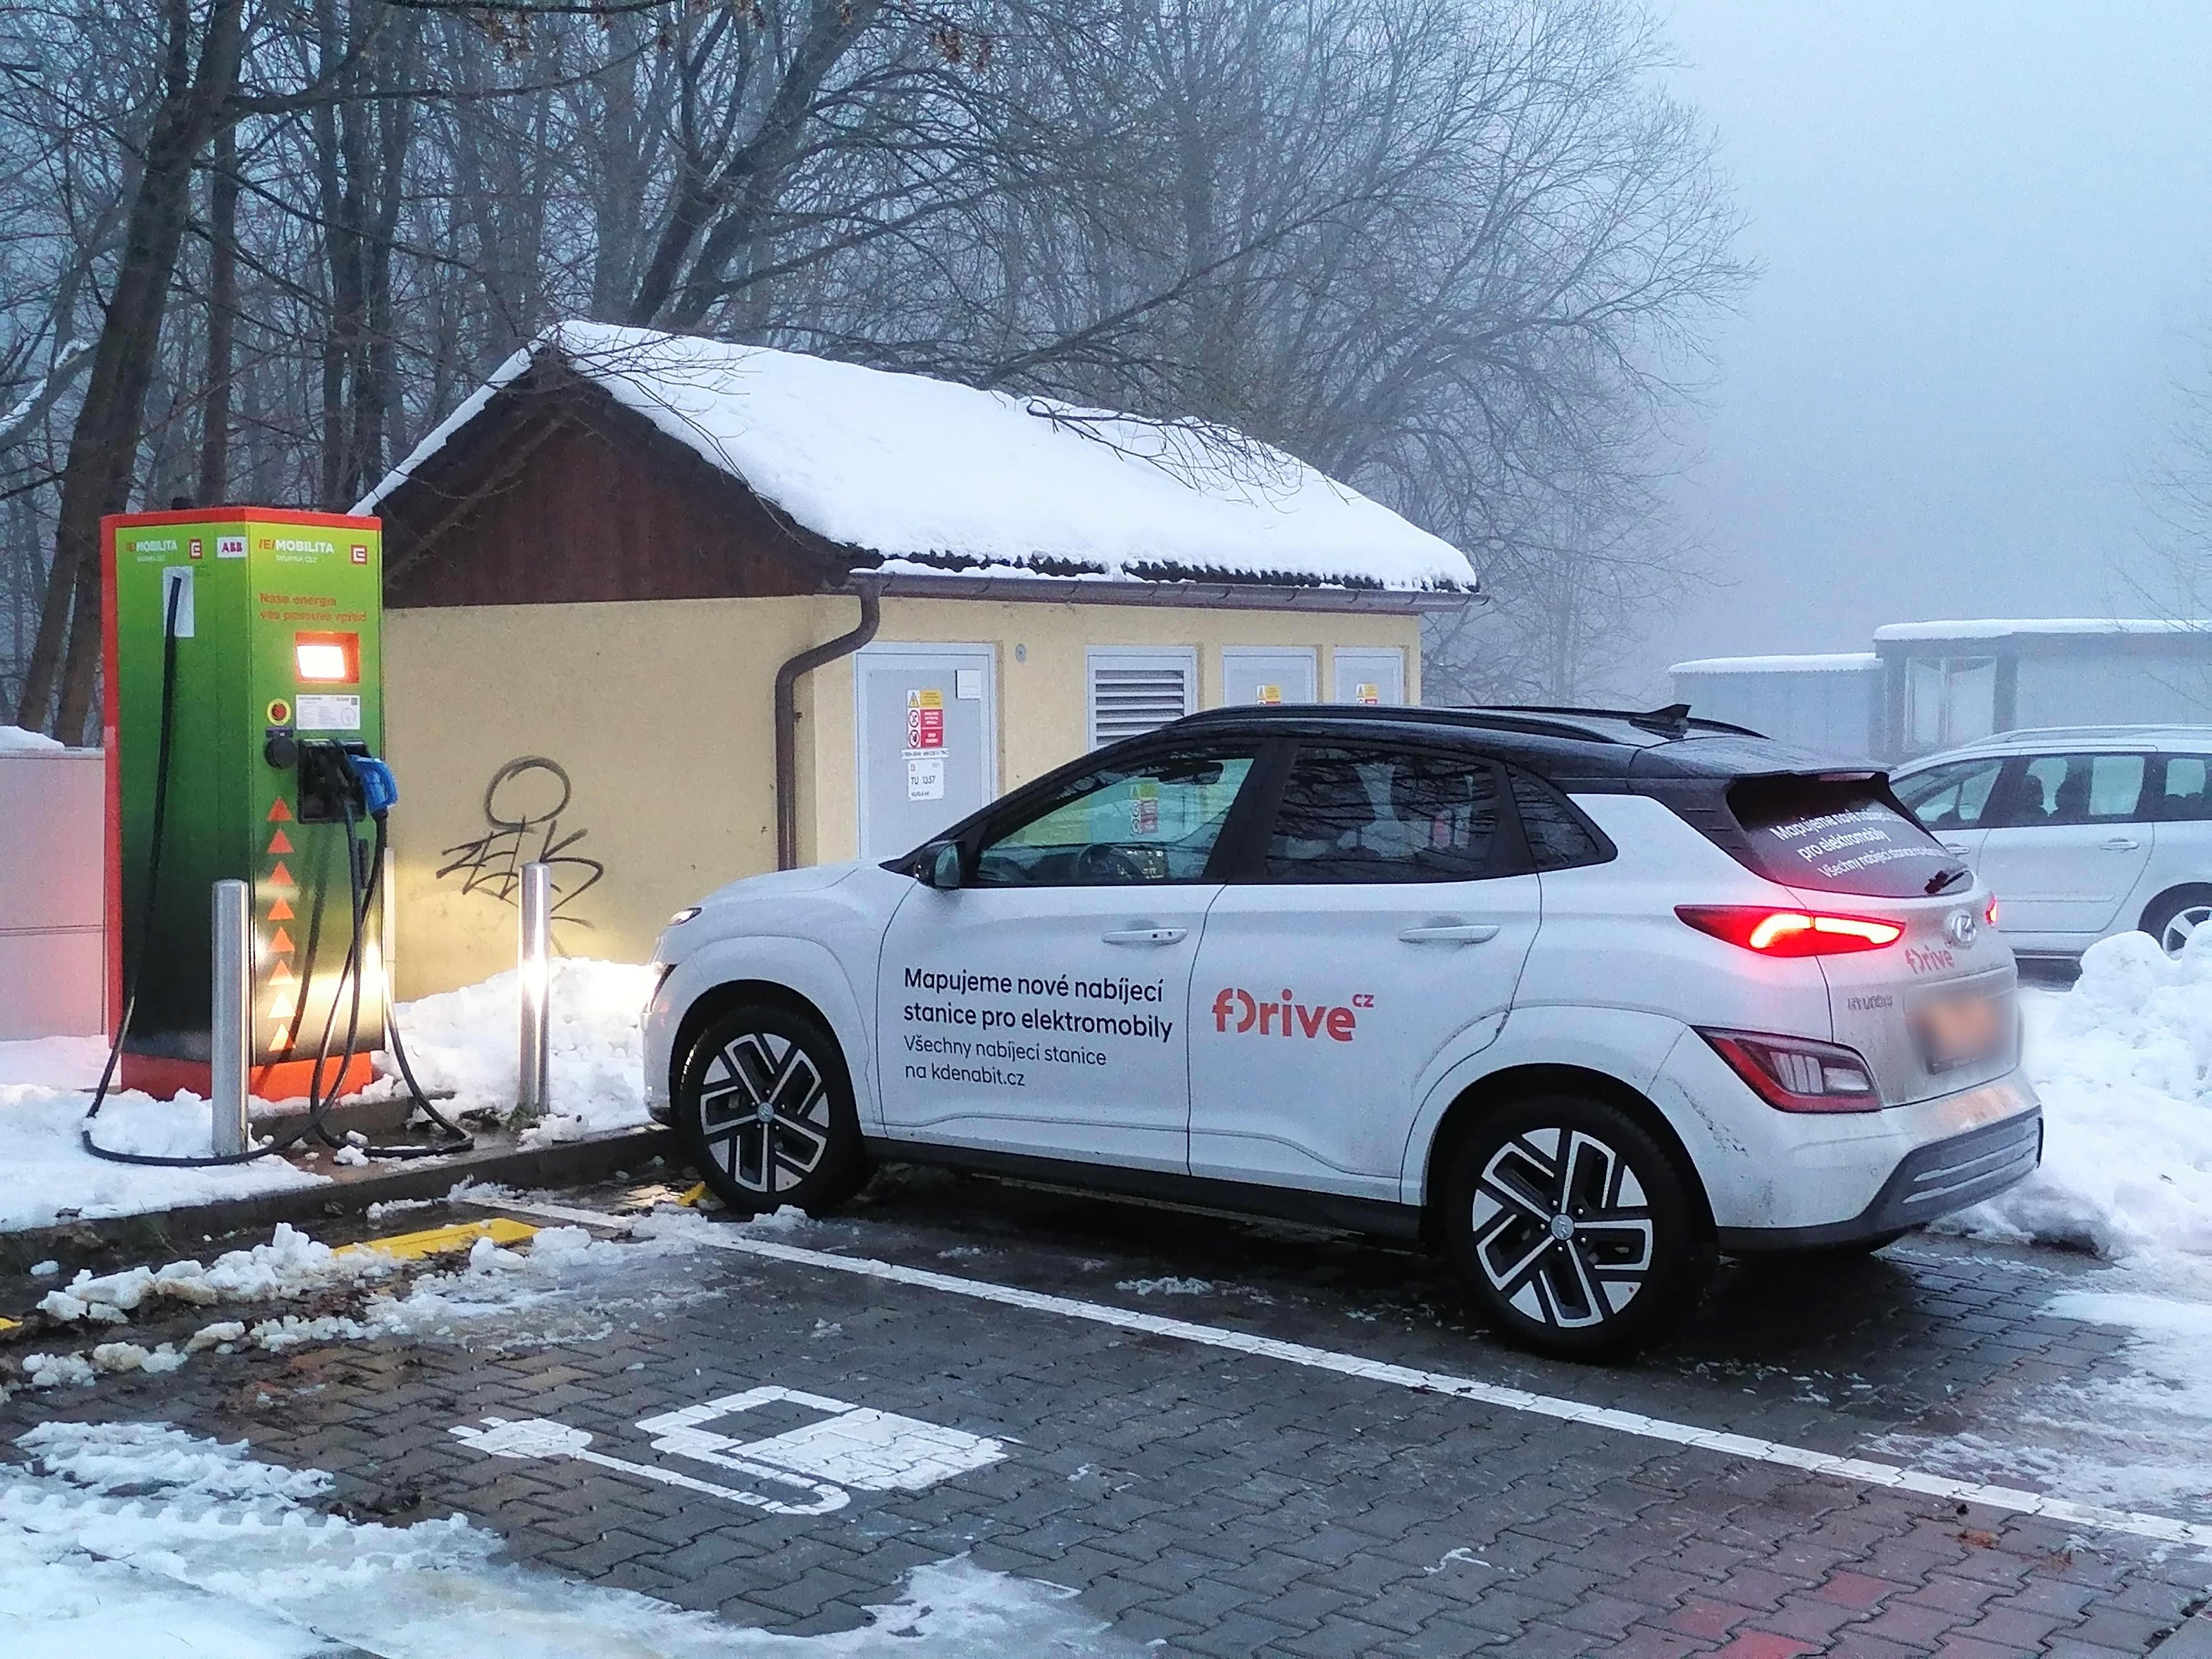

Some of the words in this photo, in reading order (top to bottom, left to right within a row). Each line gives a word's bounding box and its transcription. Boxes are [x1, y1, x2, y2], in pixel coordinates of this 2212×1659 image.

[221, 542, 243, 552] ABB
[1769, 816, 1839, 841] Mapujeme
[1796, 844, 1824, 863] pro
[904, 968, 1011, 995] Mapujeme
[1018, 974, 1069, 997] nové
[1075, 977, 1164, 1005] nabíjecí
[904, 1003, 976, 1025] stanice
[982, 1010, 1016, 1030] pro
[1022, 1008, 1173, 1043] elektromobily
[1212, 988, 1356, 1042] fDrive
[904, 1035, 971, 1058] Všechny
[976, 1041, 1040, 1062] nabíjecí
[1045, 1045, 1107, 1065] stanice
[905, 1064, 927, 1078] na
[932, 1063, 1025, 1087] kdenabit.cz
